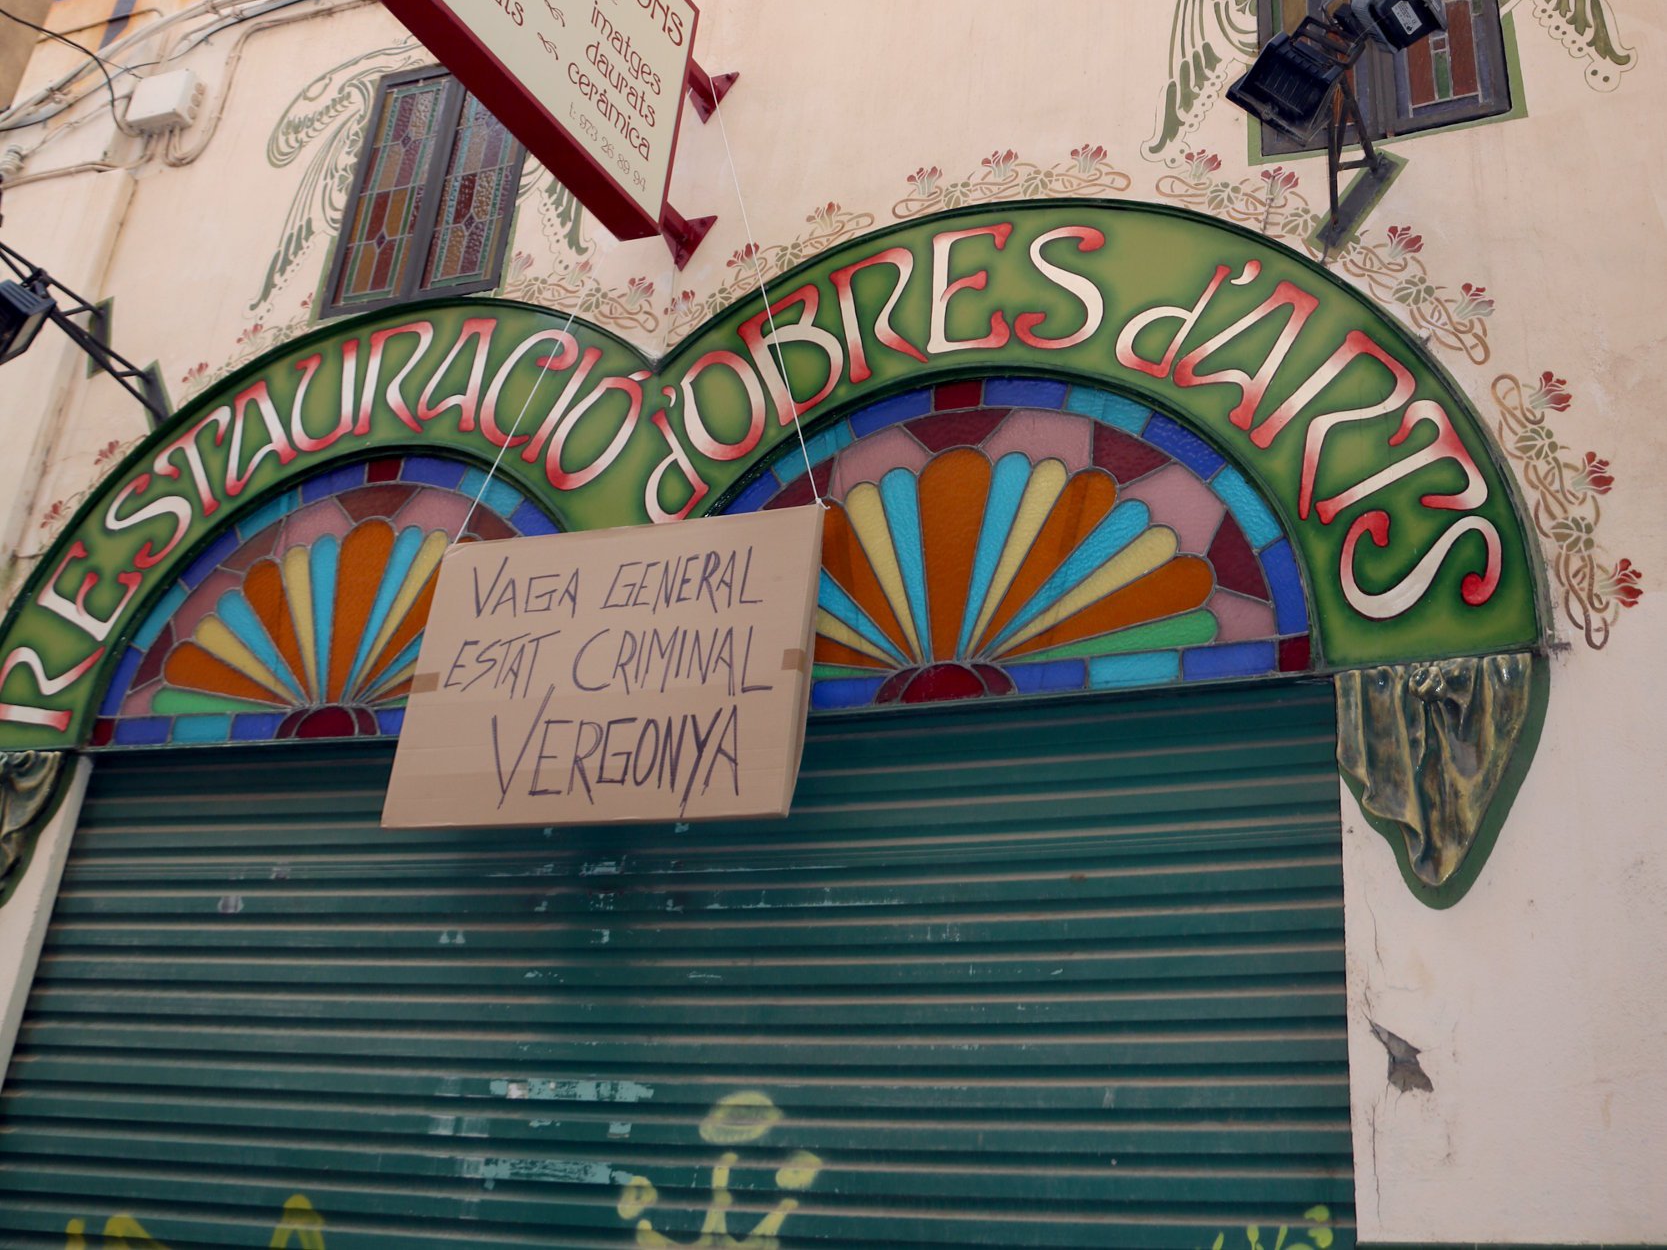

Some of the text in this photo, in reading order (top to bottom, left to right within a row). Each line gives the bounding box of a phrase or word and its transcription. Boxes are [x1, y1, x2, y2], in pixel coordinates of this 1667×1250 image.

[585, 41, 656, 128] daurats
[590, 0, 662, 96] imatges
[567, 62, 650, 162] ceràmica
[579, 114, 598, 141] 973
[600, 136, 615, 159] 26
[617, 153, 631, 175] 89
[633, 170, 646, 192] 94
[0, 221, 1502, 732] RESTAURACIÓ d'OBRES d'ARTS
[473, 545, 764, 619] VAGA GENERAL
[443, 624, 773, 700] ESTAT CRIMINAL
[491, 683, 740, 818] VERGONYA
